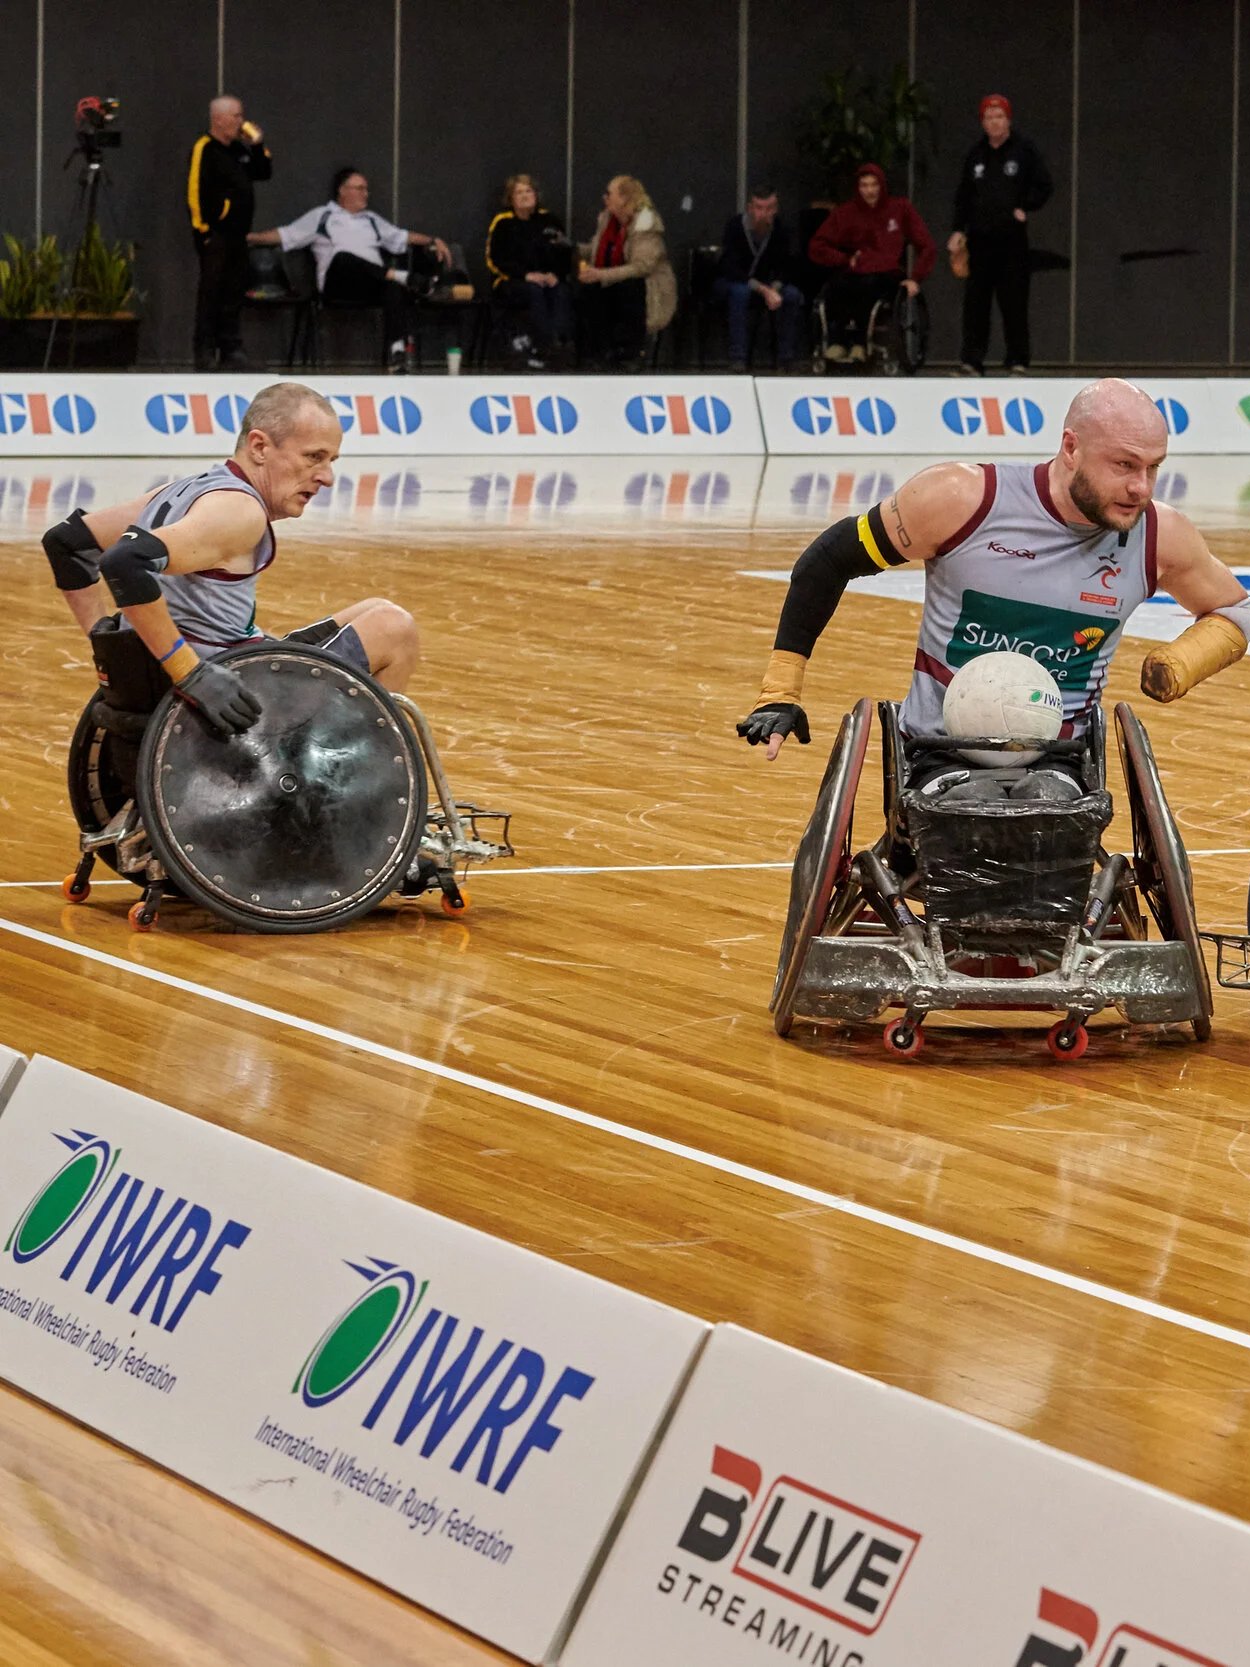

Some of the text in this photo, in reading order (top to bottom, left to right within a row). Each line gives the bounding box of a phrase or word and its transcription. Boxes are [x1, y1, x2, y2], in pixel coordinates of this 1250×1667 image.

[470, 395, 578, 436] GIO
[625, 395, 732, 436] GIO
[792, 396, 897, 436] GIO
[941, 397, 1044, 437] GIO
[60, 1172, 252, 1334] IWRF
[33, 1301, 91, 1349] Wheelchair
[86, 1329, 122, 1371] Rugby
[119, 1347, 177, 1394] Federation
[361, 1308, 596, 1495] IWRF
[254, 1416, 514, 1565] International Wheelchair Rugby Federation
